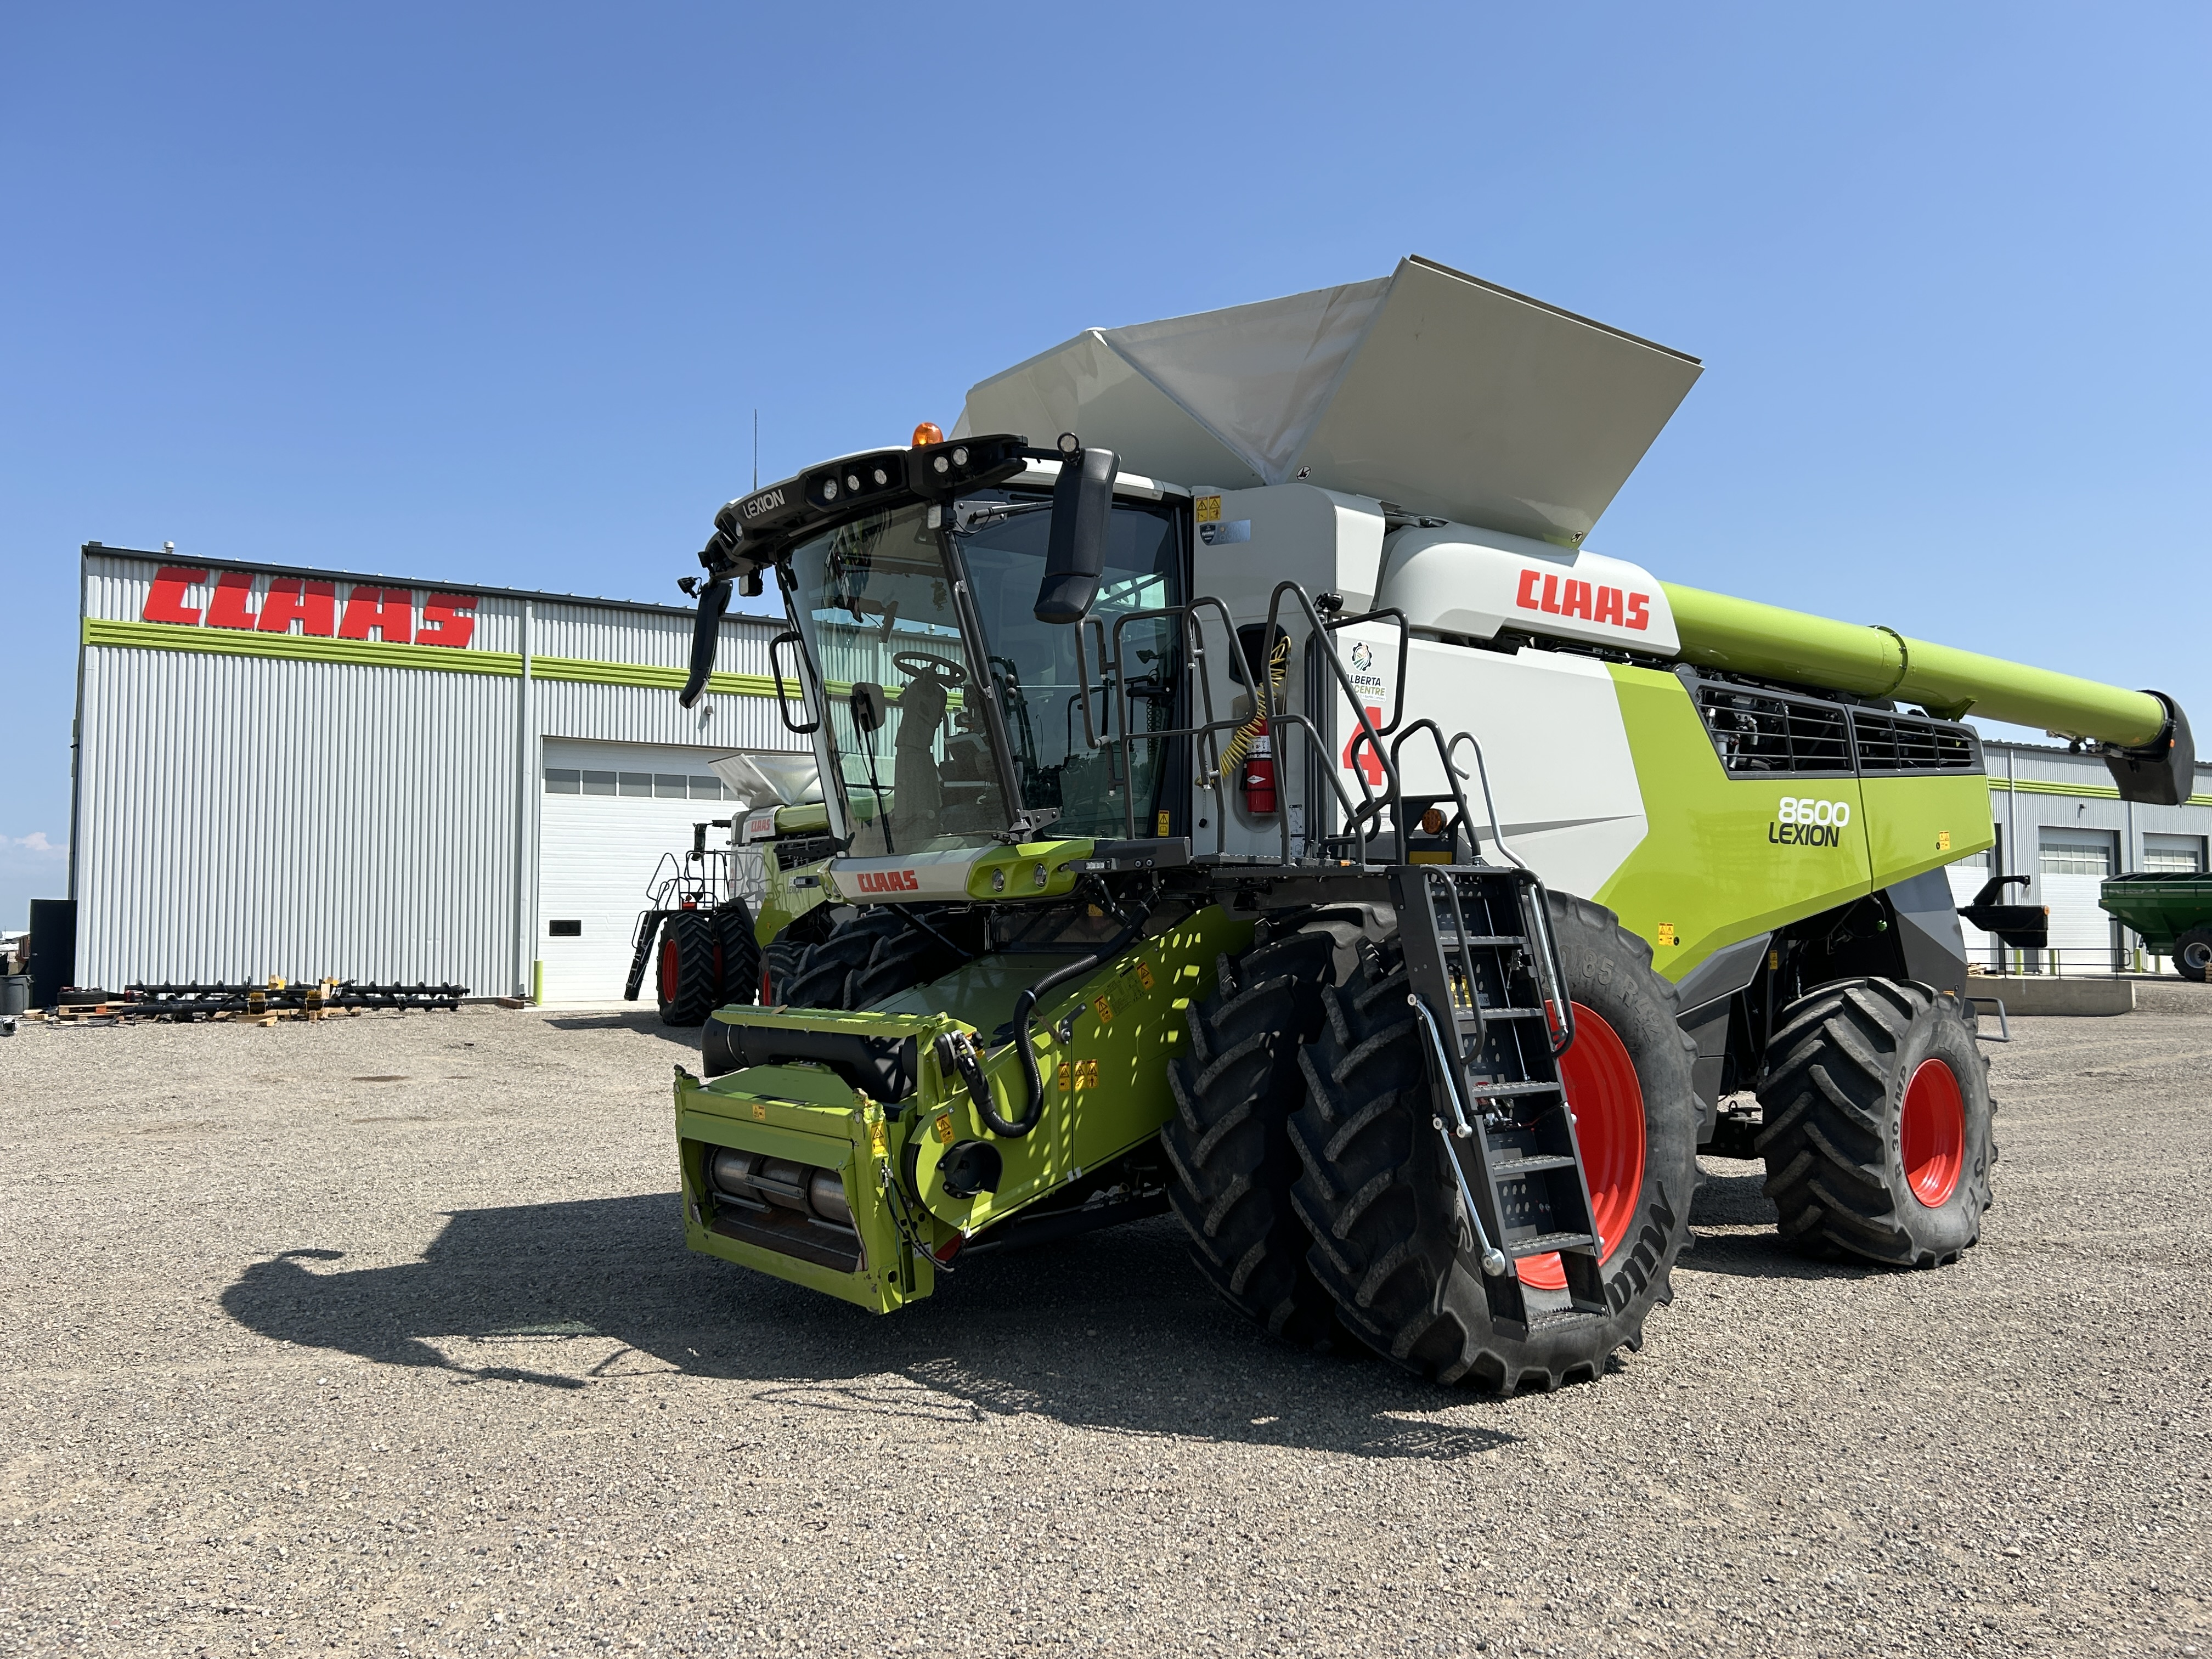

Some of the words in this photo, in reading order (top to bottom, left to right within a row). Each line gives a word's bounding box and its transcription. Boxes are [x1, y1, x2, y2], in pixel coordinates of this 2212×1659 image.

[742, 489, 786, 519] LEXION
[143, 566, 479, 648] CLAAS
[1516, 569, 1650, 631] CLAAS
[1342, 707, 1386, 786] 4
[751, 819, 770, 832] CLAAS
[1778, 797, 1850, 827] 8600
[1769, 822, 1839, 847] LEXION
[857, 870, 918, 892] CLAAS
[1604, 1180, 1675, 1314] Mita
